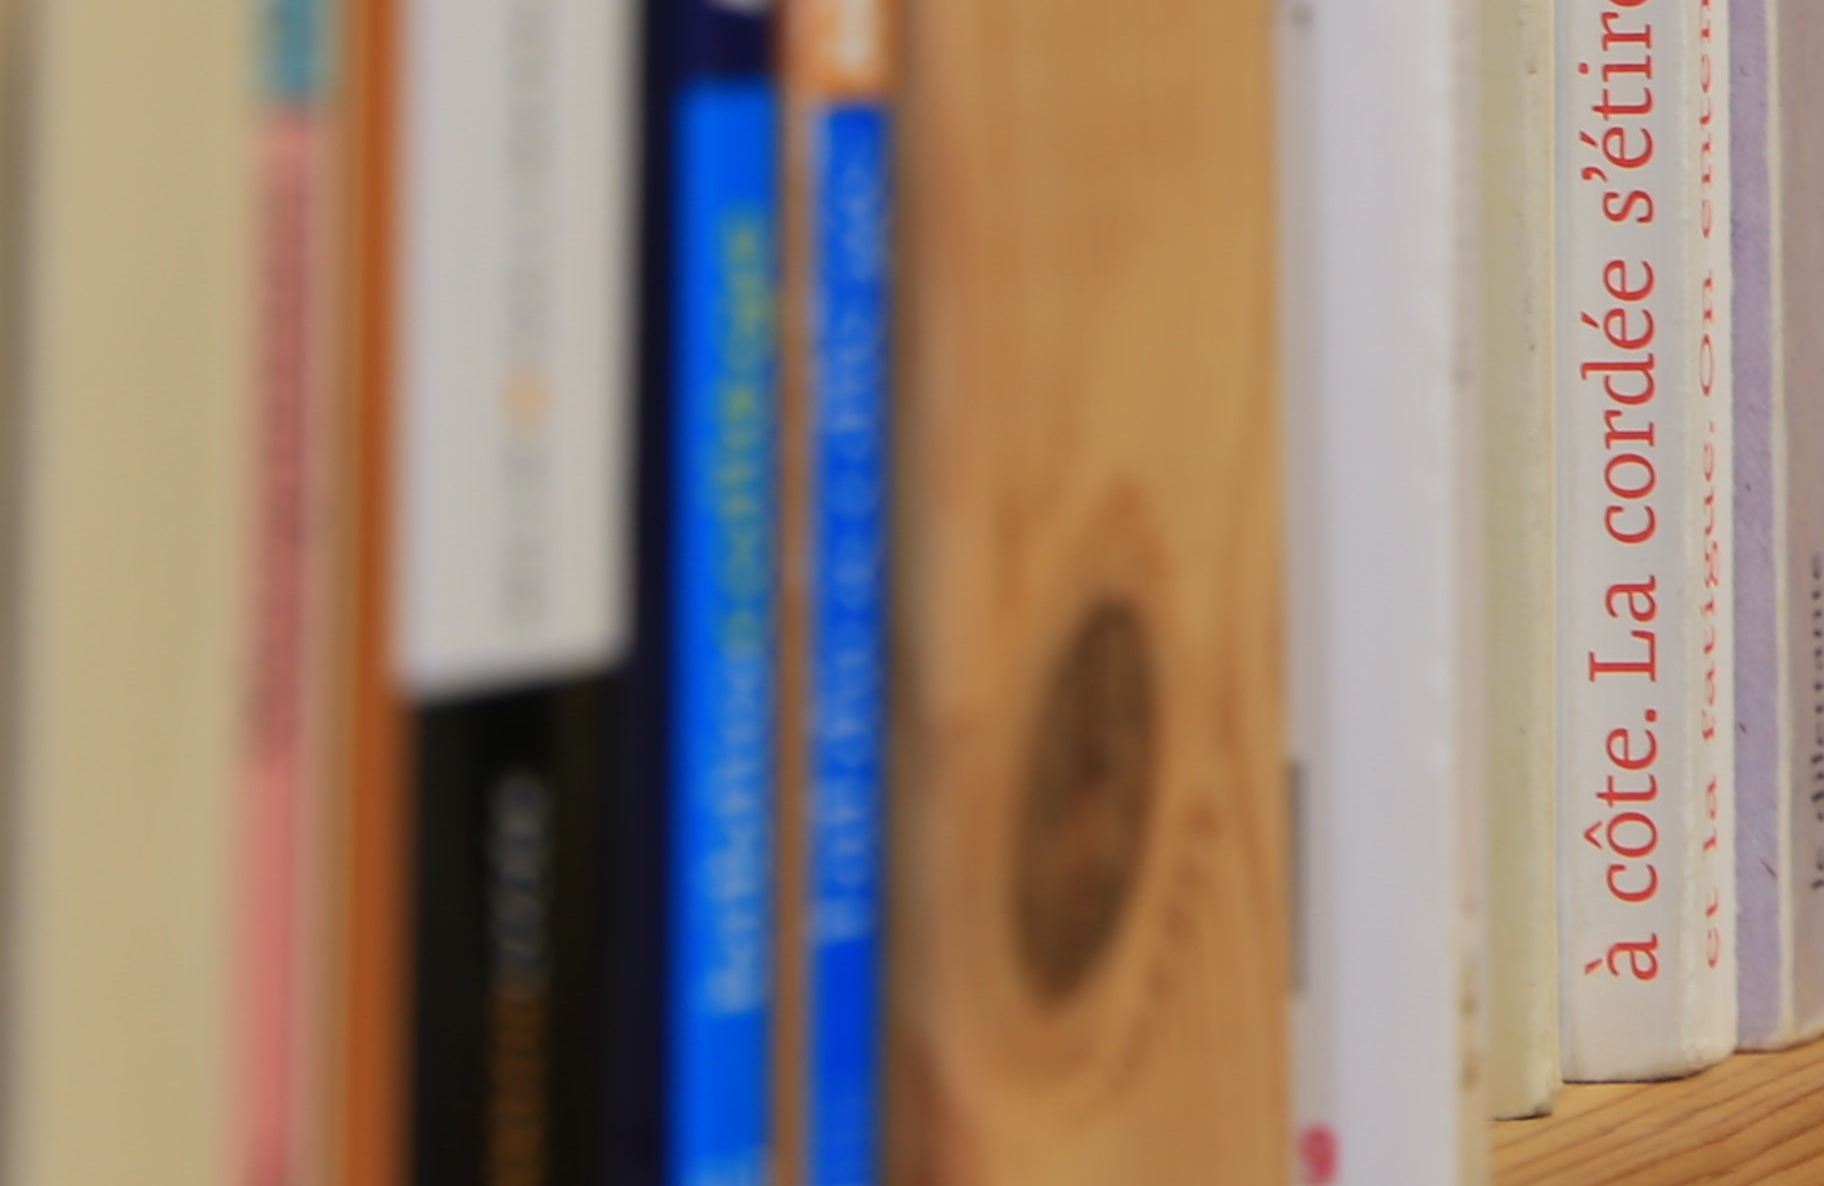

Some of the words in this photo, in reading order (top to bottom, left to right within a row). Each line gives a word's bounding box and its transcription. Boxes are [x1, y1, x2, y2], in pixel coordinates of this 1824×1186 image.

[1697, 268, 1719, 399] On
[1578, 257, 1660, 547] cordée
[1586, 574, 1660, 684] La
[1697, 422, 1723, 743] fatigue.
[1582, 706, 1661, 906] côte.
[1699, 772, 1722, 858] la
[1582, 932, 1662, 984] à
[1702, 888, 1724, 971] et
